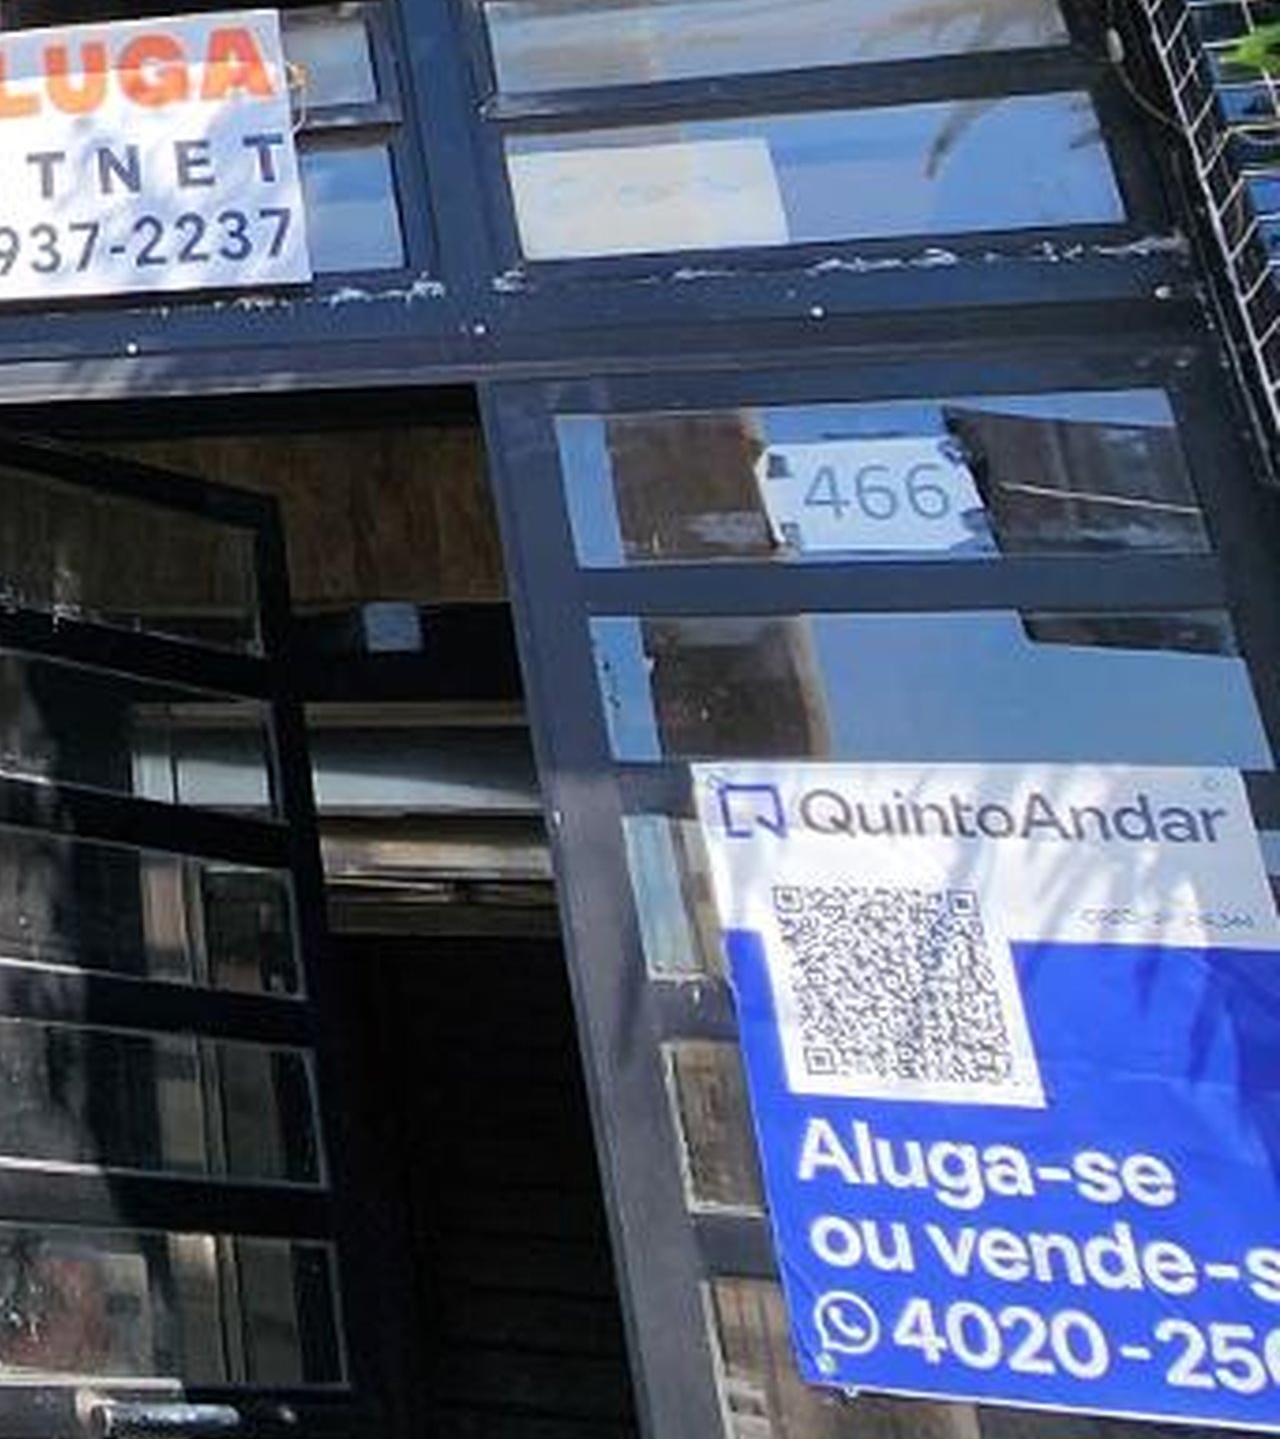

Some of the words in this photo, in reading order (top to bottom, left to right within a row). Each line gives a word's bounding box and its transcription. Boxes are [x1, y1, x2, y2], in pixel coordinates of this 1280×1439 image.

[803, 463, 950, 520] 466
[799, 788, 1227, 843] QuintoAndar
[798, 1117, 1177, 1211] Aluga-se
[809, 1215, 915, 1272] ou
